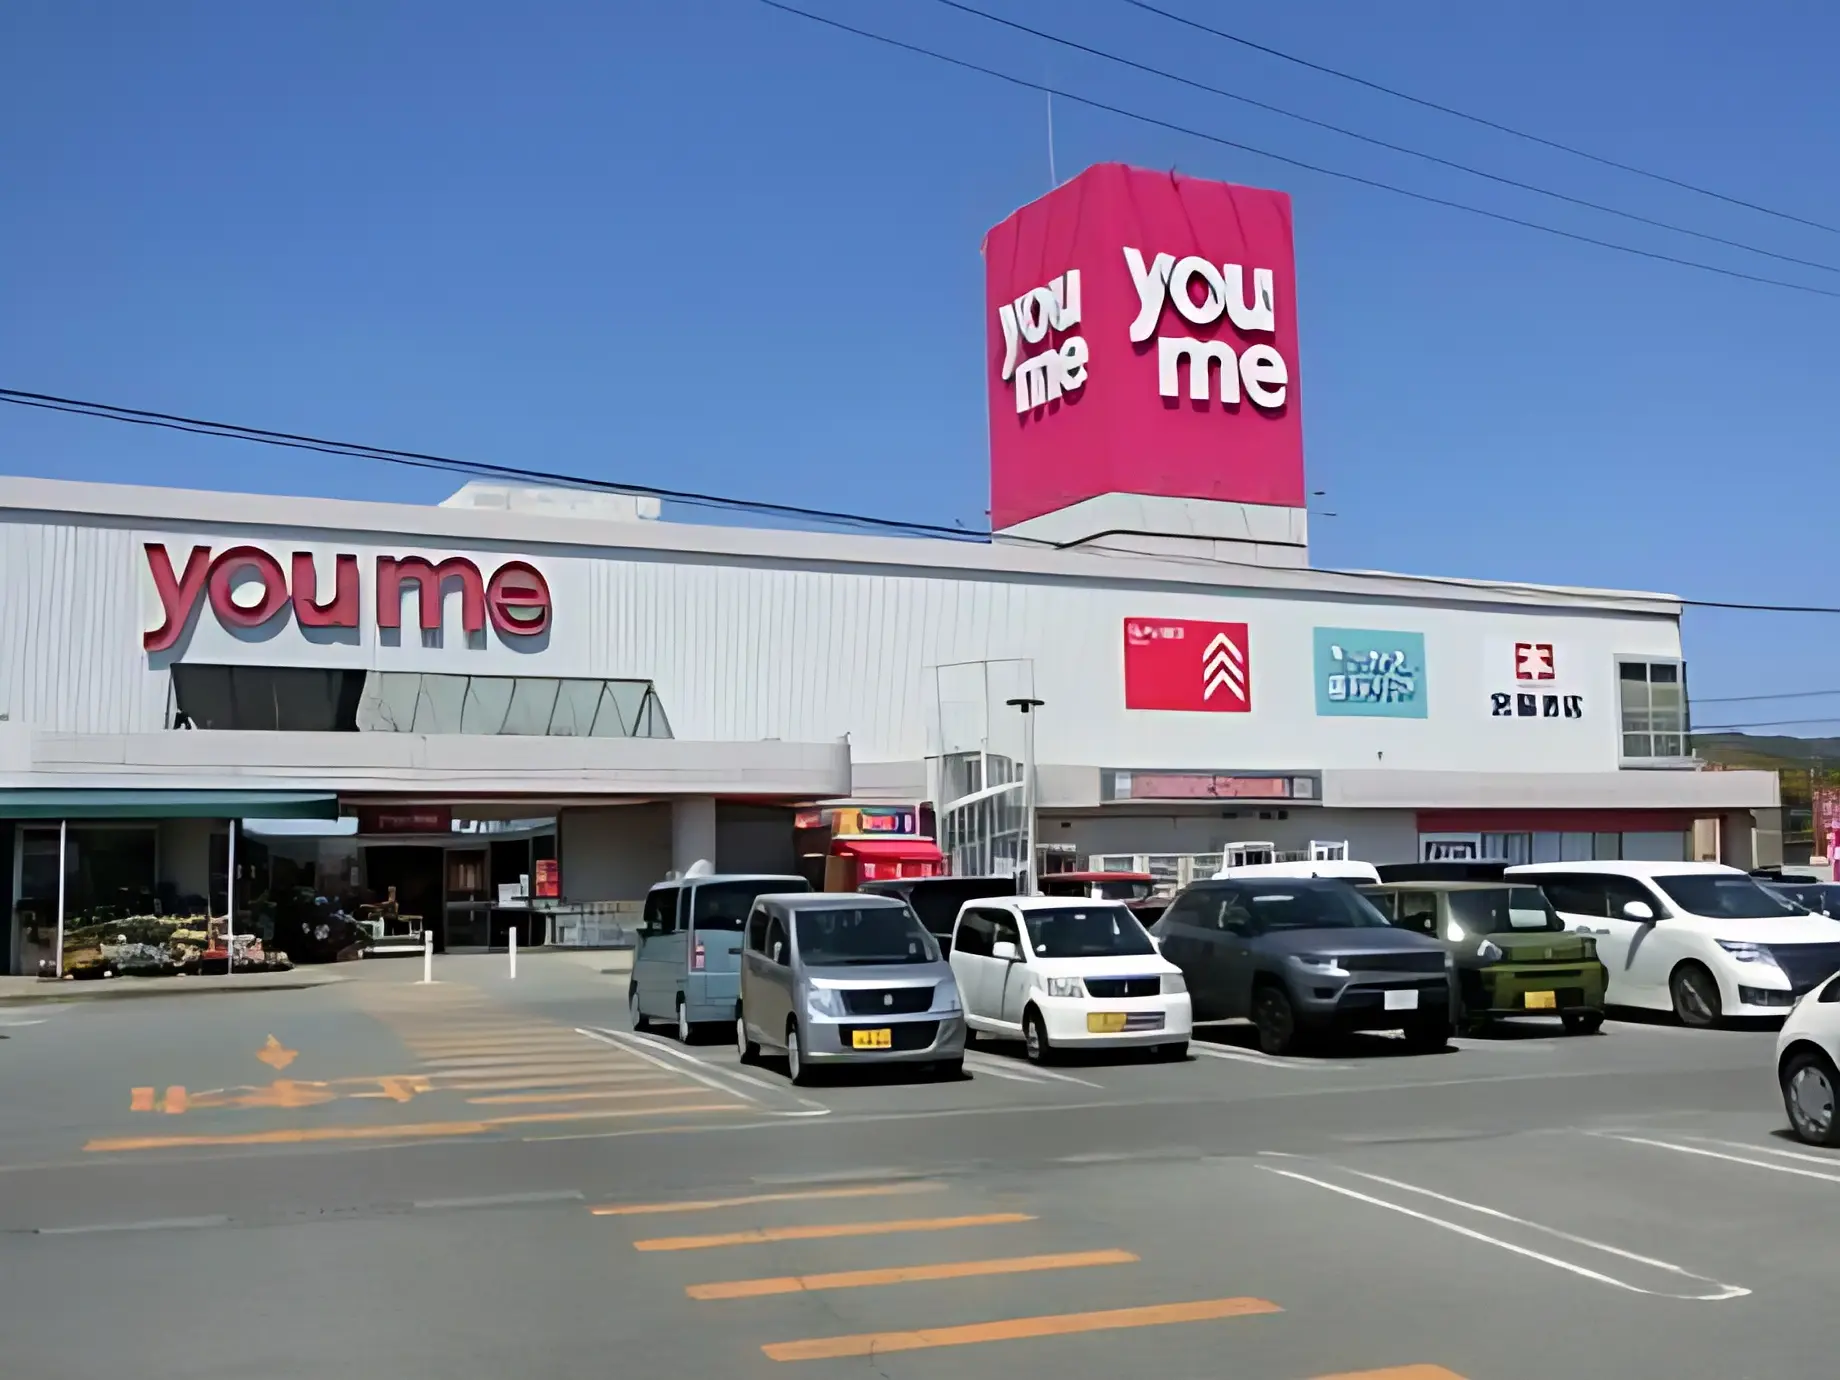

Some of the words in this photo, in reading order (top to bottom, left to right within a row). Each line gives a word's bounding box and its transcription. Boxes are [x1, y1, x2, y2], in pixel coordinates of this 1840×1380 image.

[998, 269, 1081, 381] you
[1122, 246, 1275, 343] you
[1015, 335, 1089, 414] me
[1157, 336, 1289, 409] me
